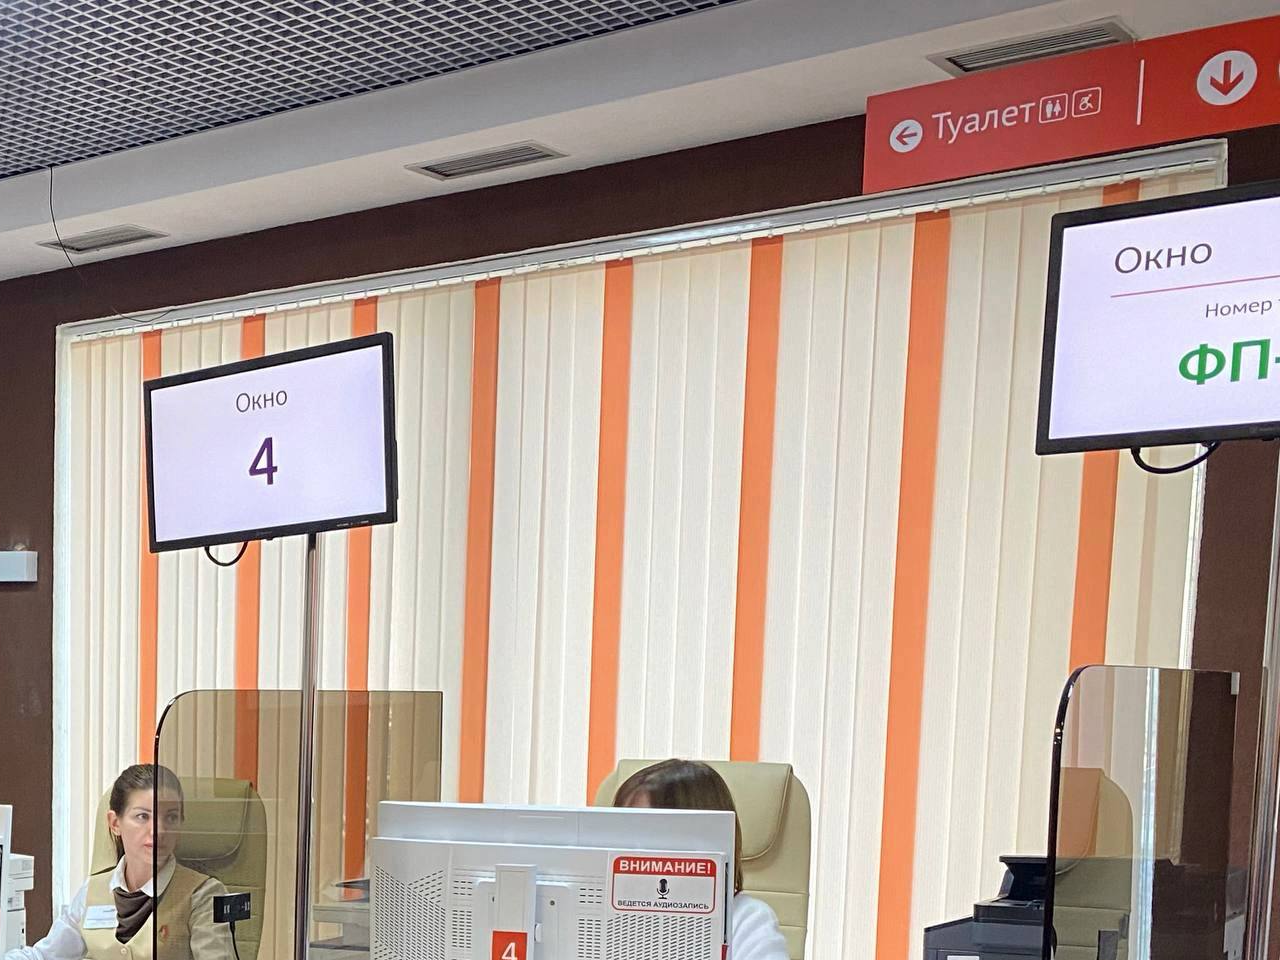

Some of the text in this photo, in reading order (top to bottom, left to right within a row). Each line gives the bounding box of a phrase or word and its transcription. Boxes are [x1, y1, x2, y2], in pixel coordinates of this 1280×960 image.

[931, 101, 1036, 144] Туалет
[1114, 242, 1213, 275] Окно
[1205, 300, 1273, 318] Номер
[1178, 338, 1280, 385] ФП
[235, 390, 288, 413] Окно
[248, 436, 278, 486] 4
[619, 859, 712, 875] ВНИМАНИЕ!
[617, 900, 709, 910] ВЕДЕТСЯ АУДИОЗАПИСЬ
